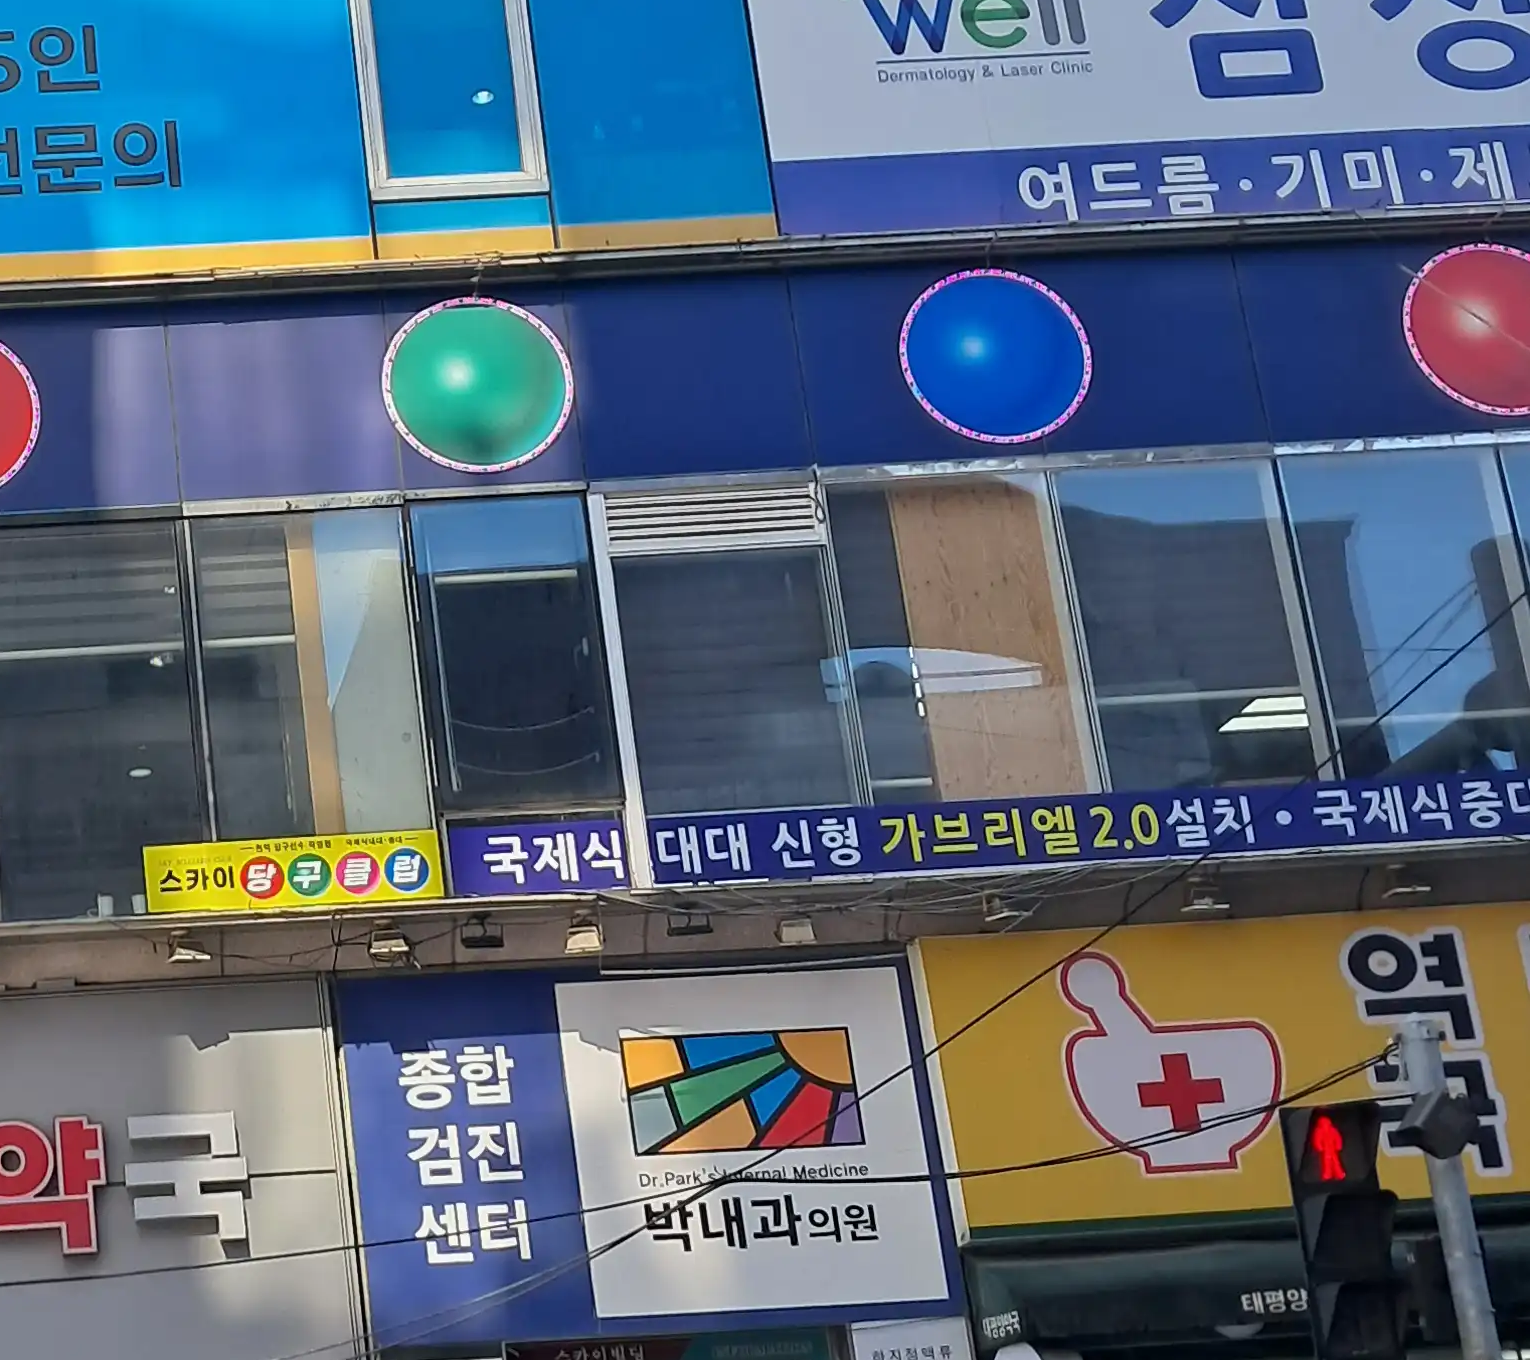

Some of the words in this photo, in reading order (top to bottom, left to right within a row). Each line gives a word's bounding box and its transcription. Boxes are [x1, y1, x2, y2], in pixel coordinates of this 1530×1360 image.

[877, 65, 976, 84] Dermatology
[982, 63, 995, 78] &
[1000, 62, 1044, 78] Laser
[1050, 60, 1094, 75] Clinic
[482, 831, 625, 886] 국제식
[656, 821, 751, 877] 대대
[770, 814, 863, 871] 신형
[879, 803, 1078, 864] 가브리엘
[396, 1043, 517, 1111] 종합
[405, 1119, 526, 1188] 검진
[792, 1161, 870, 1180] Medicine
[413, 1198, 533, 1266] 센터
